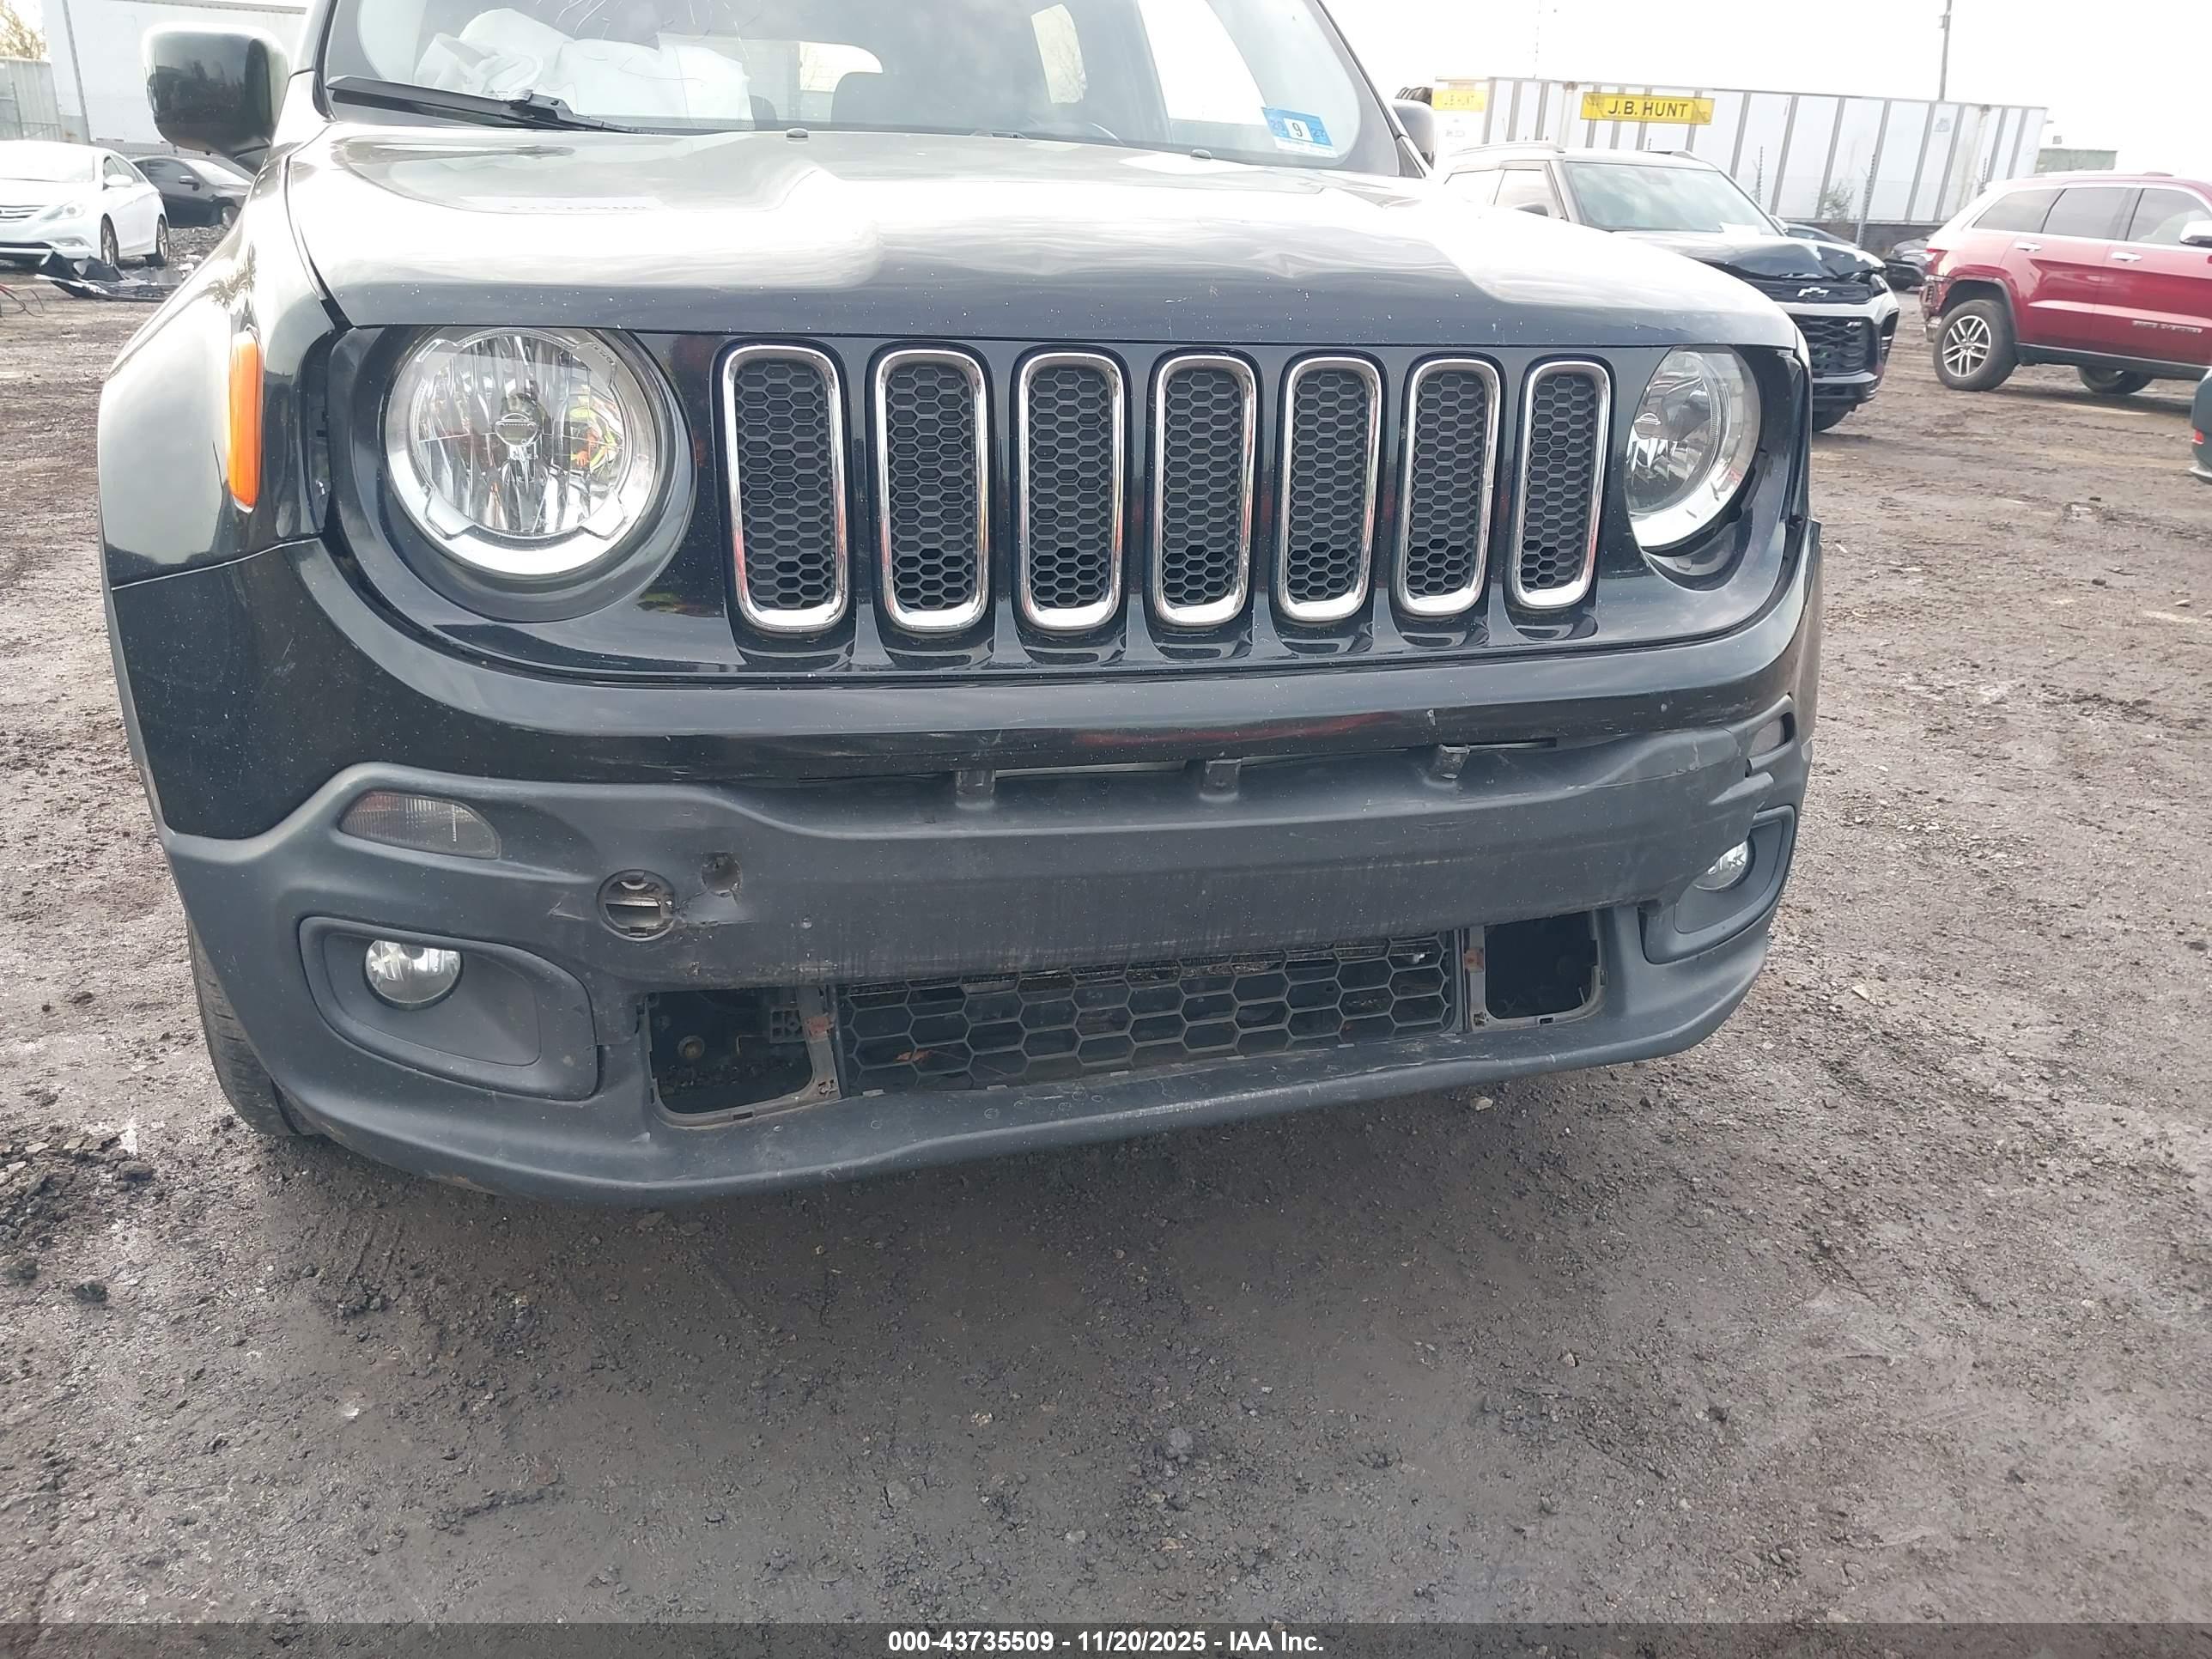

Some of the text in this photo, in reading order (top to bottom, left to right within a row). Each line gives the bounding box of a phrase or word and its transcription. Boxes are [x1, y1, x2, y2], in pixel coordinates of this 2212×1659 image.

[1607, 100, 1688, 118] J.B. HUNT
[1291, 122, 1303, 137] 9
